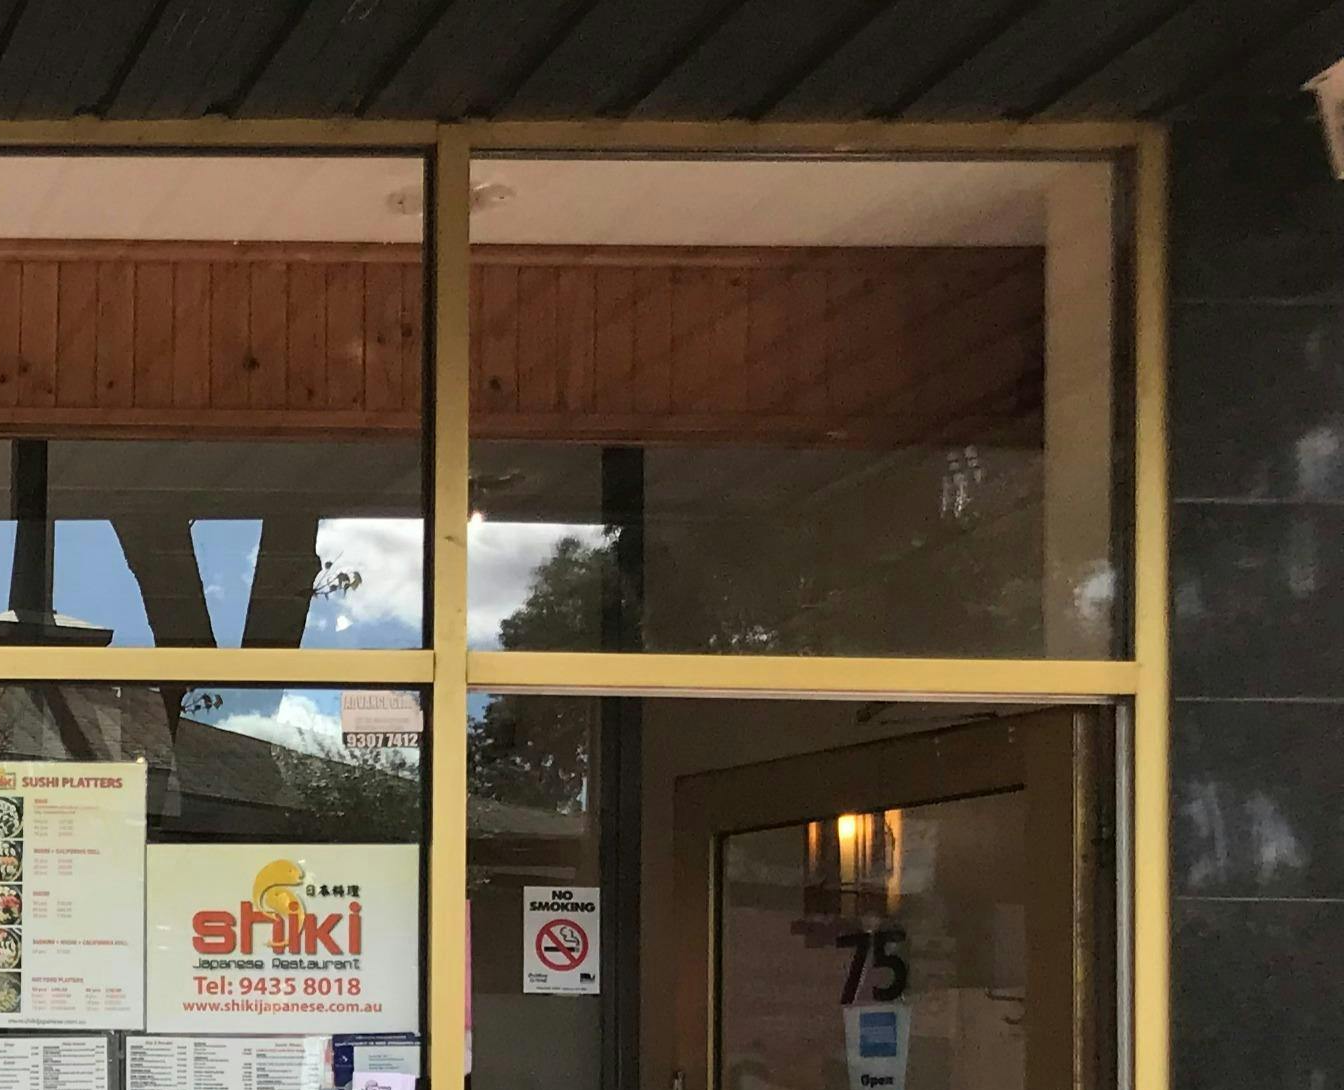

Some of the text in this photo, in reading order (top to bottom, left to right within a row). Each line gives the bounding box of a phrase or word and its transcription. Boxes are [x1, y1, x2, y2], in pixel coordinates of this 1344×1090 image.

[346, 733, 384, 747] 9307
[22, 777, 59, 788] SUSHI
[62, 777, 123, 789] PLATTERS
[552, 890, 573, 900] NO
[529, 901, 595, 912] SMOKING
[192, 901, 362, 955] shiki
[193, 958, 360, 971] Japanese Restaurant
[836, 926, 909, 1004] 75
[193, 976, 361, 996] Tel: 9435 8018
[183, 1000, 383, 1015] www.shikijapanese.com.au
